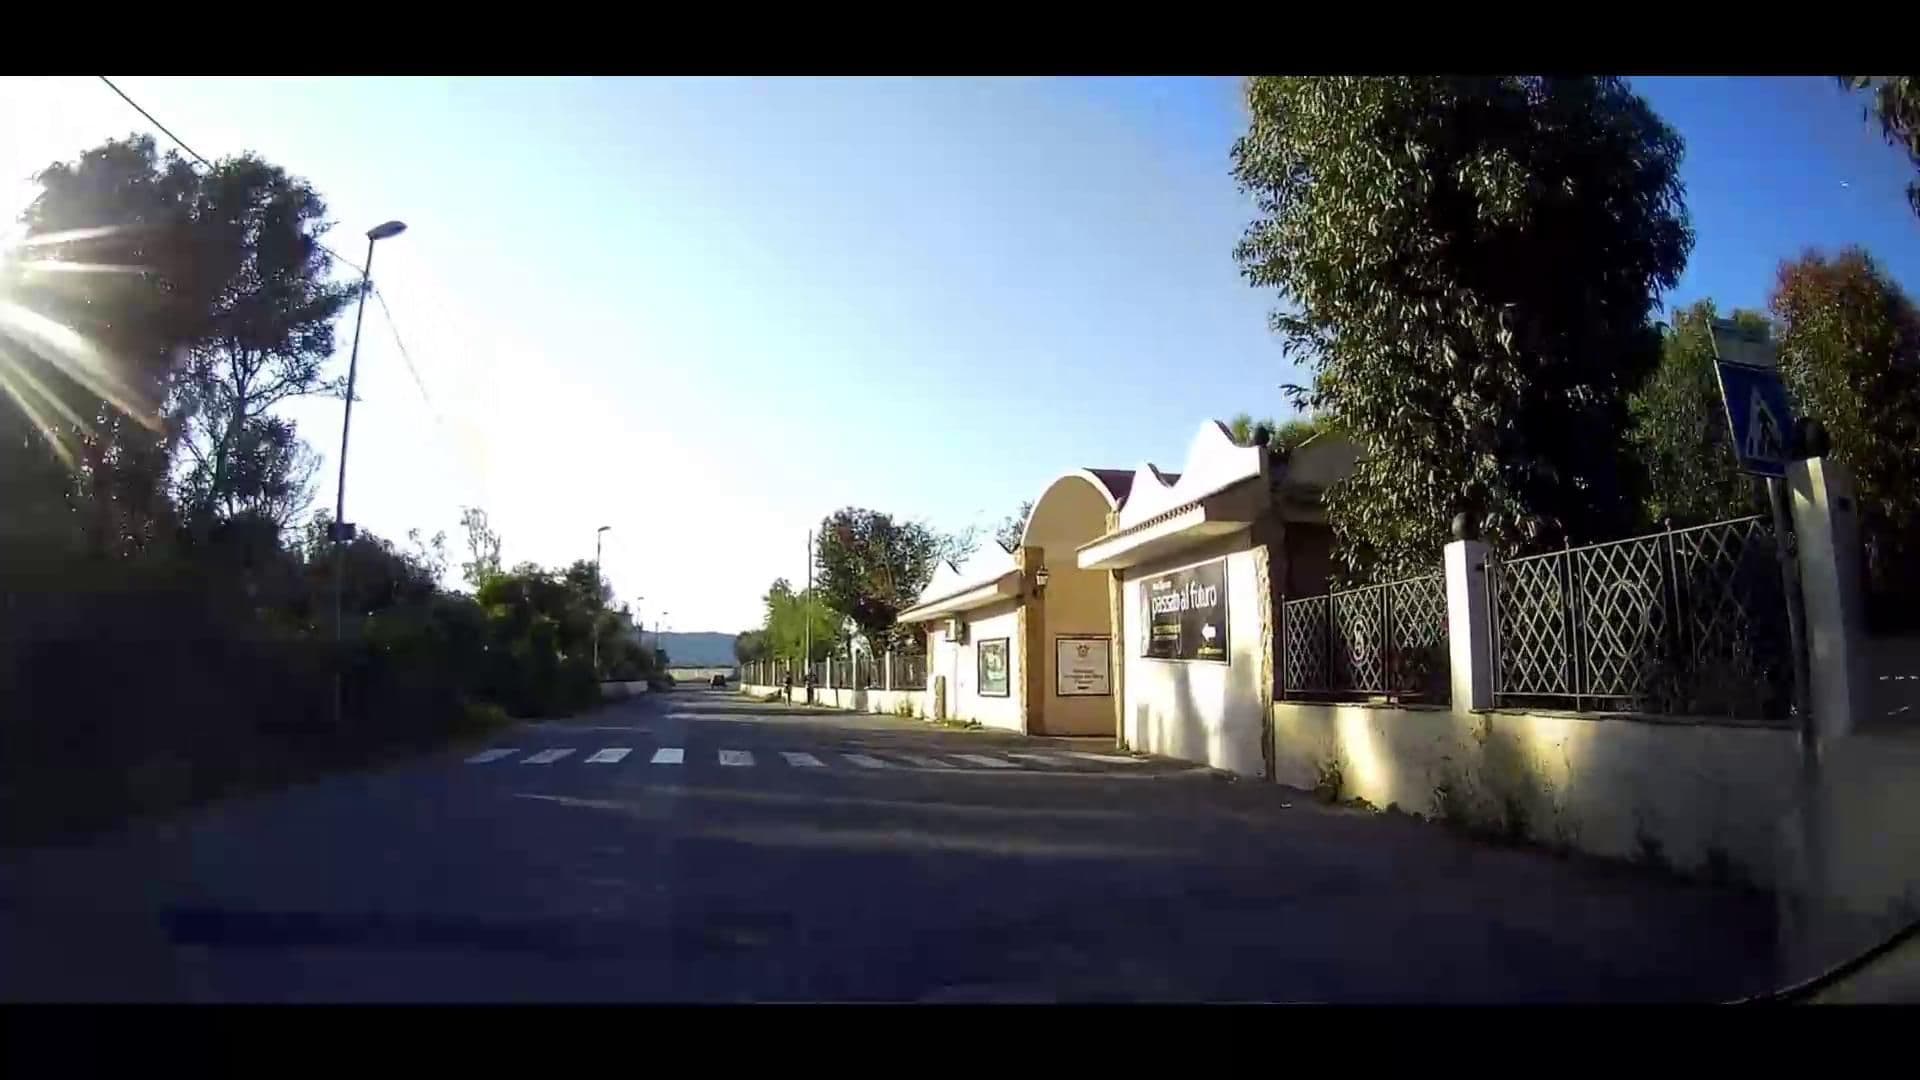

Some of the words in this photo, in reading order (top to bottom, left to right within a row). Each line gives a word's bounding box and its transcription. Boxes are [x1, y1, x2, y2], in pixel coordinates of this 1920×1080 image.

[1152, 590, 1180, 621] passato
[1180, 582, 1190, 611] al
[1190, 580, 1217, 609] futuro
